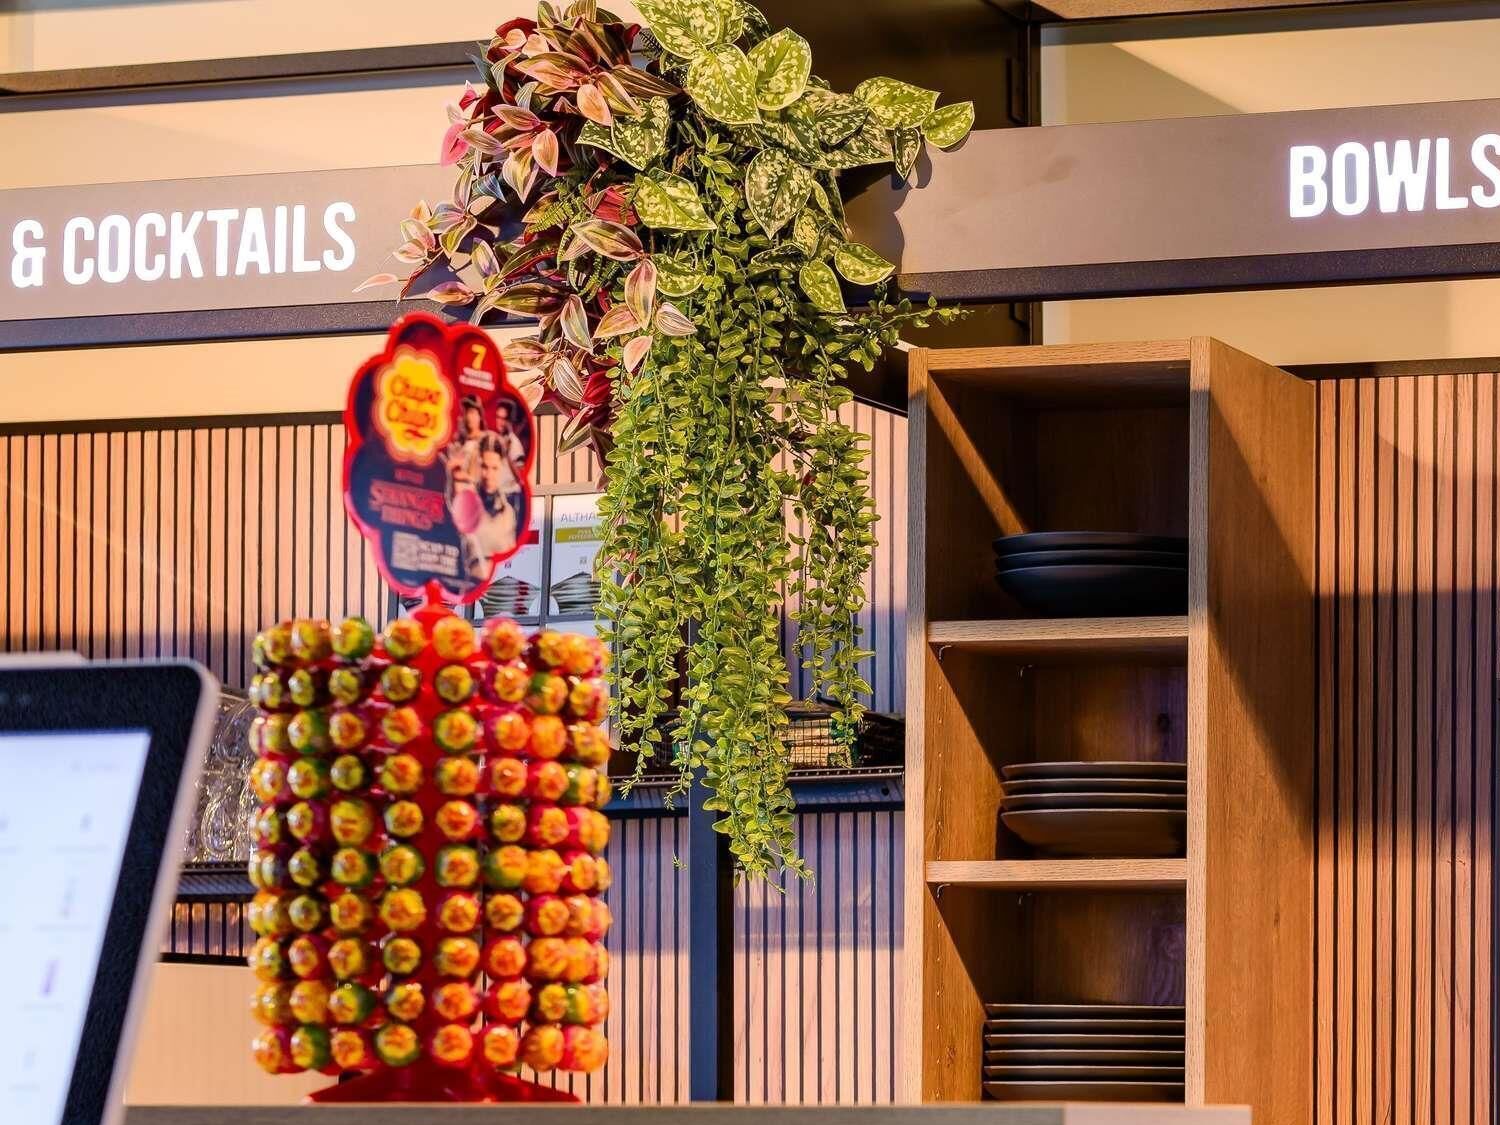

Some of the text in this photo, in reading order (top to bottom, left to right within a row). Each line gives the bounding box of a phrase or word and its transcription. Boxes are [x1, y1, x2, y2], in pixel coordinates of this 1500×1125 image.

[11, 202, 356, 288] & COCKTAILS
[471, 344, 487, 370] 7
